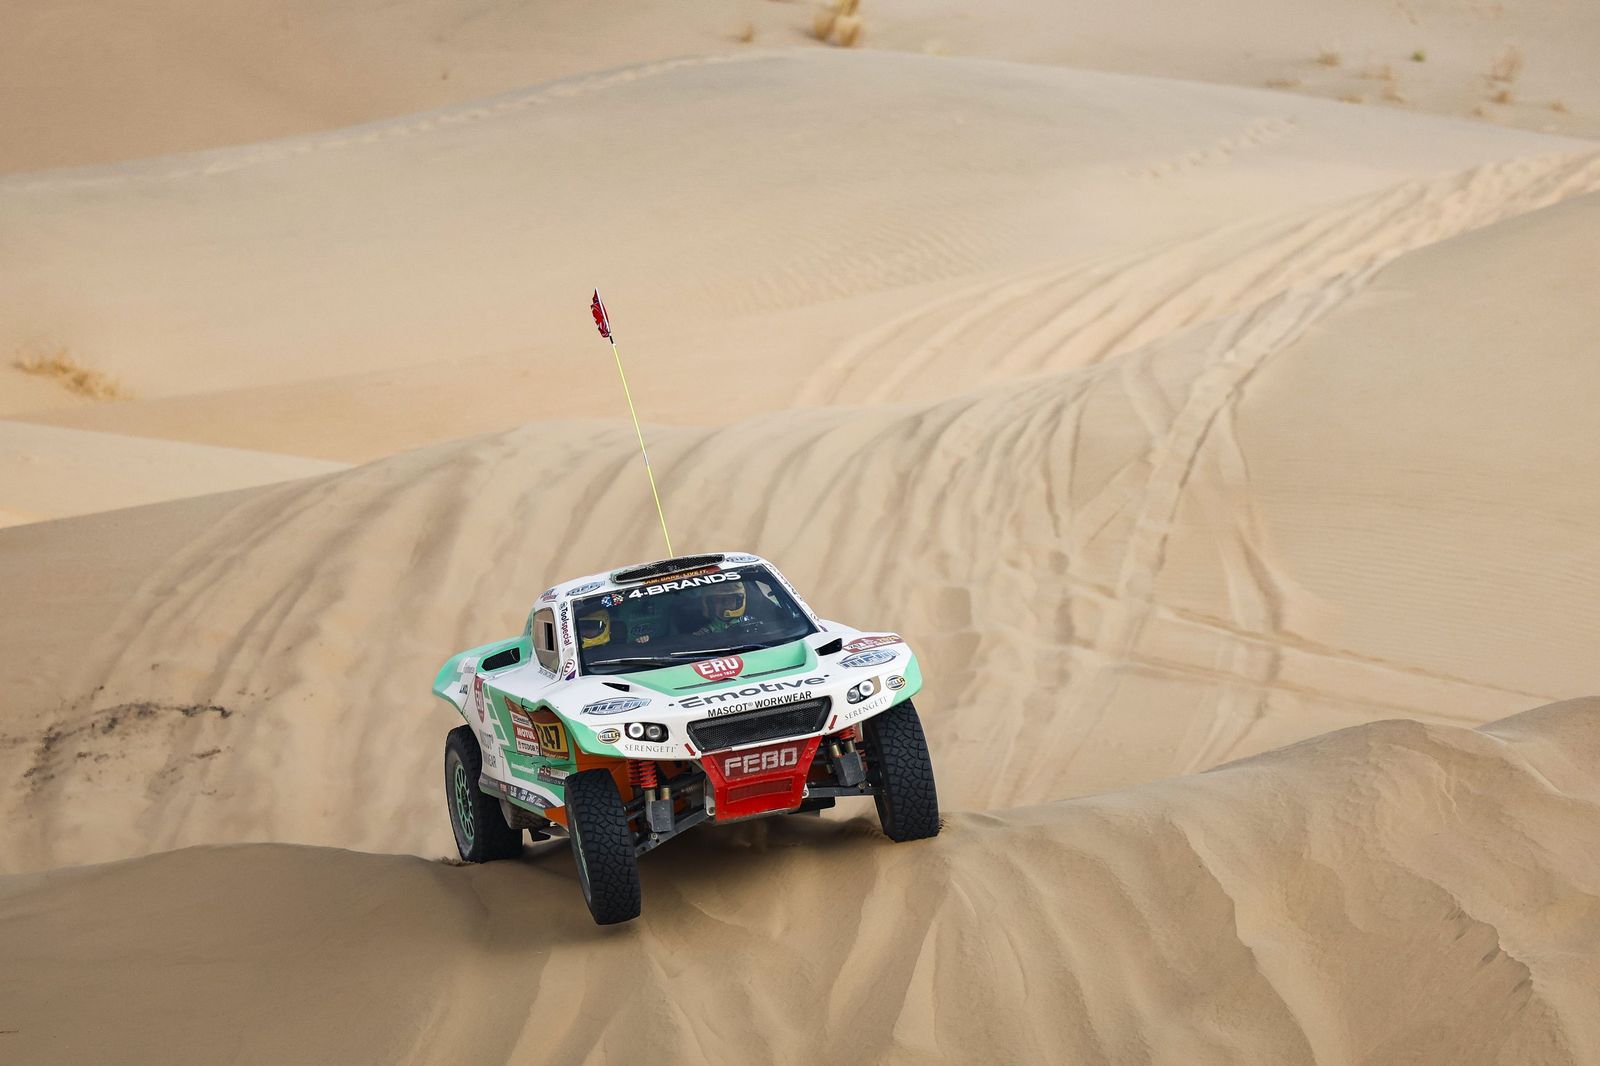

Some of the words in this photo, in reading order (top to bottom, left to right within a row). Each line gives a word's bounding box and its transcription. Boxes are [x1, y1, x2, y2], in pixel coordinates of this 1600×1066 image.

[561, 607, 572, 646] Toolspecial
[697, 657, 739, 675] ERU
[755, 691, 812, 708] WORKWEAR
[517, 727, 536, 740] MOTUL
[536, 724, 561, 750] 247
[600, 730, 621, 739] HELLA
[624, 744, 675, 753] SERENGETI
[724, 747, 797, 777] FEBO
